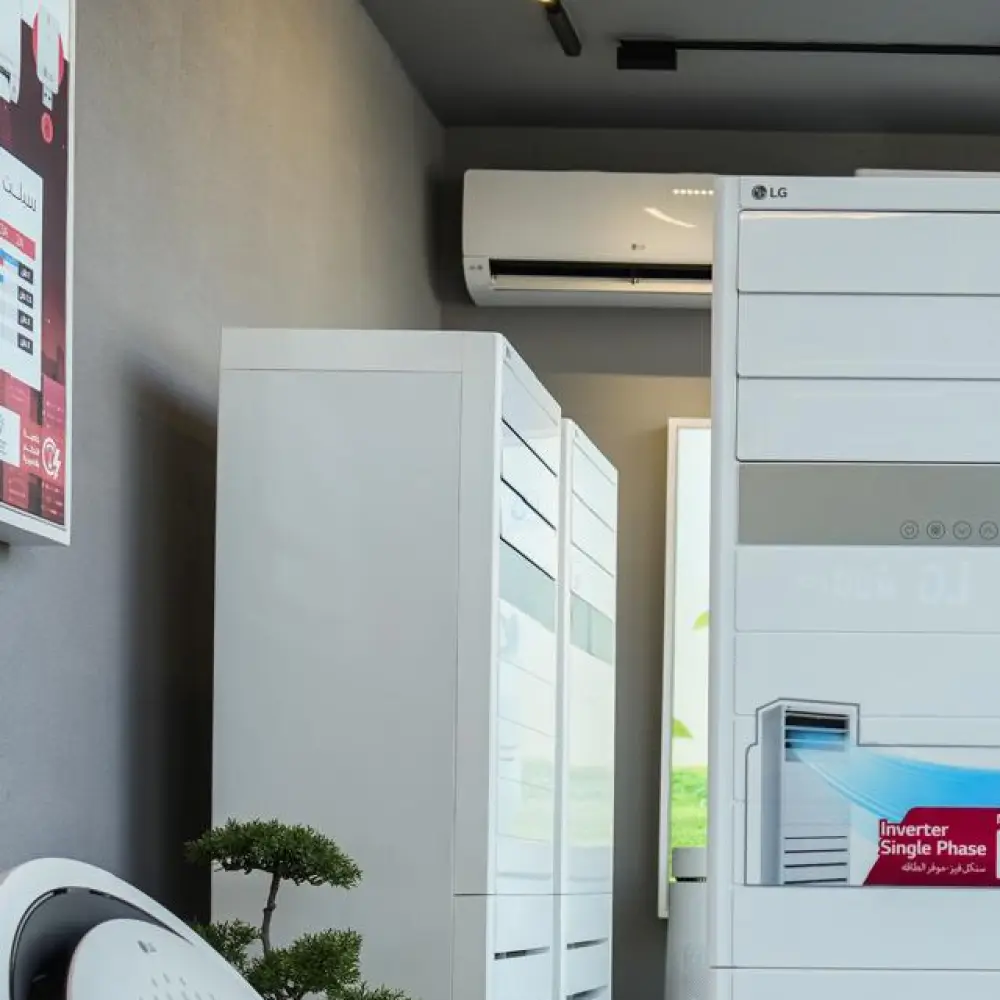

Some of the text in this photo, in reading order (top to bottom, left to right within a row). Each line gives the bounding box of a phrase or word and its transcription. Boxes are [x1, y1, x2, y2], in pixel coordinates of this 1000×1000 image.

[769, 187, 788, 198] LG
[880, 821, 949, 837] Inverter
[880, 840, 987, 859] Single Phase
